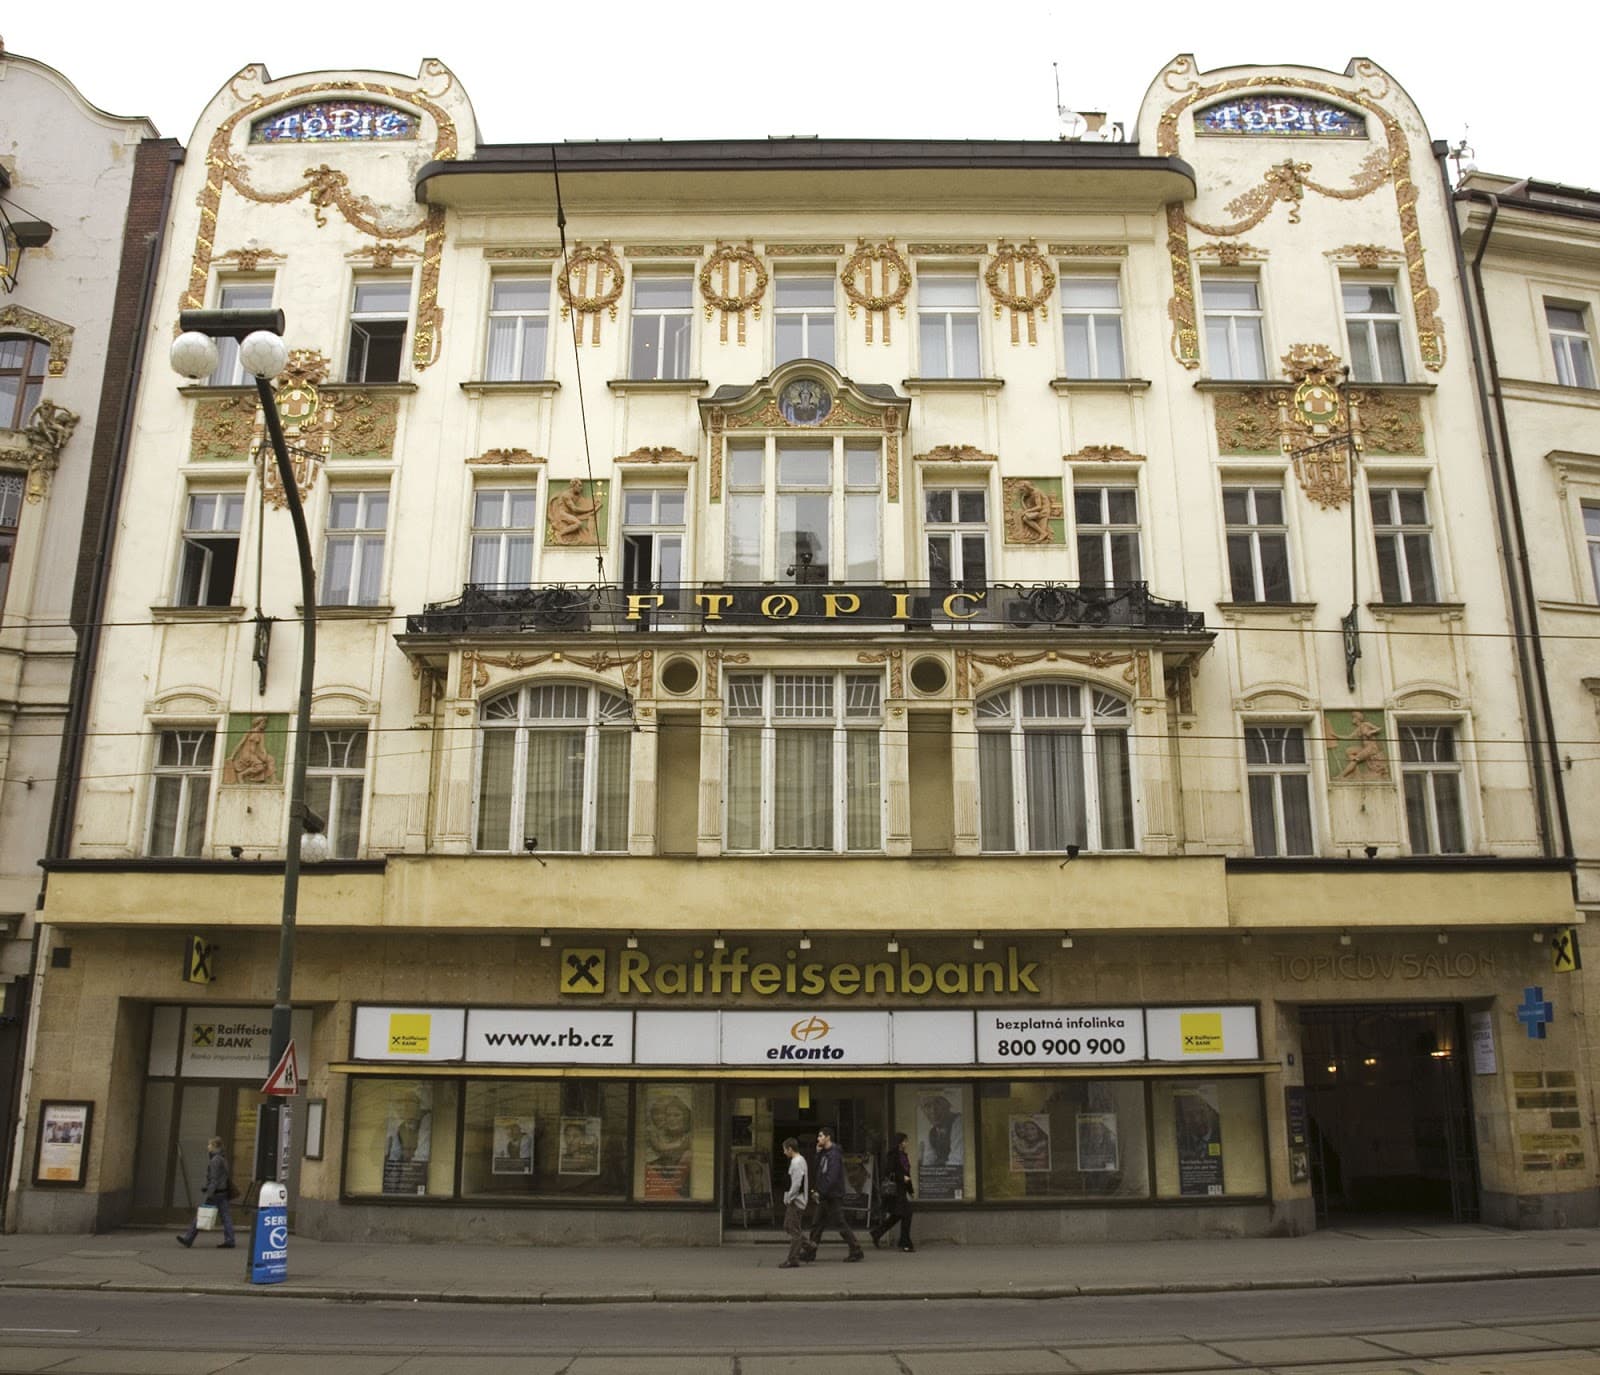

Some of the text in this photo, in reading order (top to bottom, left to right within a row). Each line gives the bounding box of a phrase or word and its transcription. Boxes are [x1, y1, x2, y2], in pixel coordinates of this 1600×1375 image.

[619, 947, 1041, 994] Raiffeisenbank
[1402, 951, 1498, 980] SALON
[996, 1017, 1125, 1032] bezplatná infolinka
[216, 1037, 253, 1049] BANK
[484, 1027, 614, 1047] www.rb.cz
[998, 1037, 1126, 1056] 800 900 900
[766, 1045, 845, 1060] eKonto
